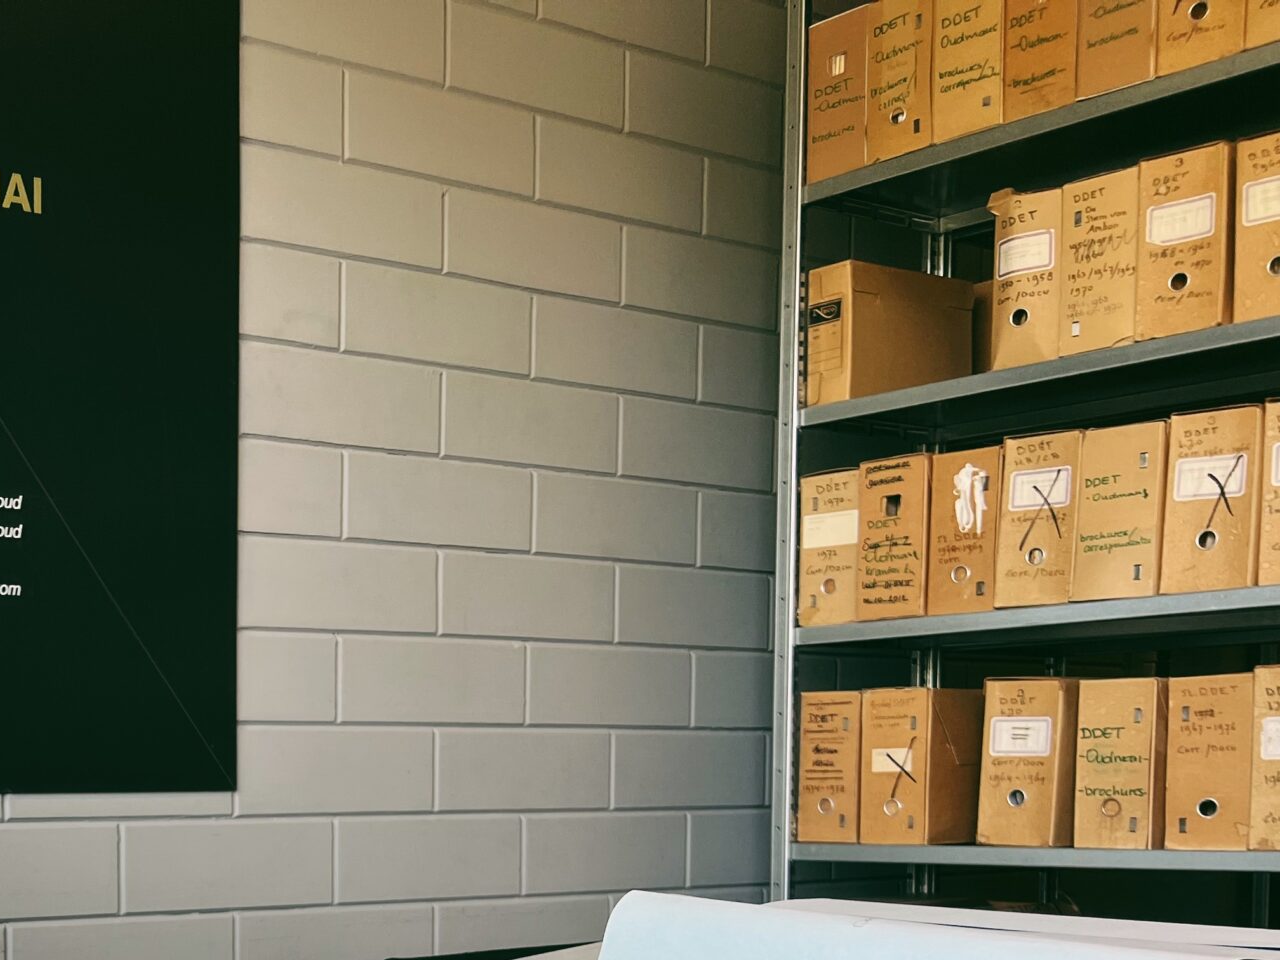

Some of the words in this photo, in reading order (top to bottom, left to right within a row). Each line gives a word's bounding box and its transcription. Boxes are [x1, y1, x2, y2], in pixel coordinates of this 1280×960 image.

[873, 12, 910, 38] DDET
[941, 5, 981, 29] DDET
[1073, 187, 1105, 203] DDET
[1001, 209, 1037, 230] DDET
[816, 481, 849, 495] DDET
[1085, 474, 1121, 488] DDET
[1079, 726, 1126, 739] DDET
